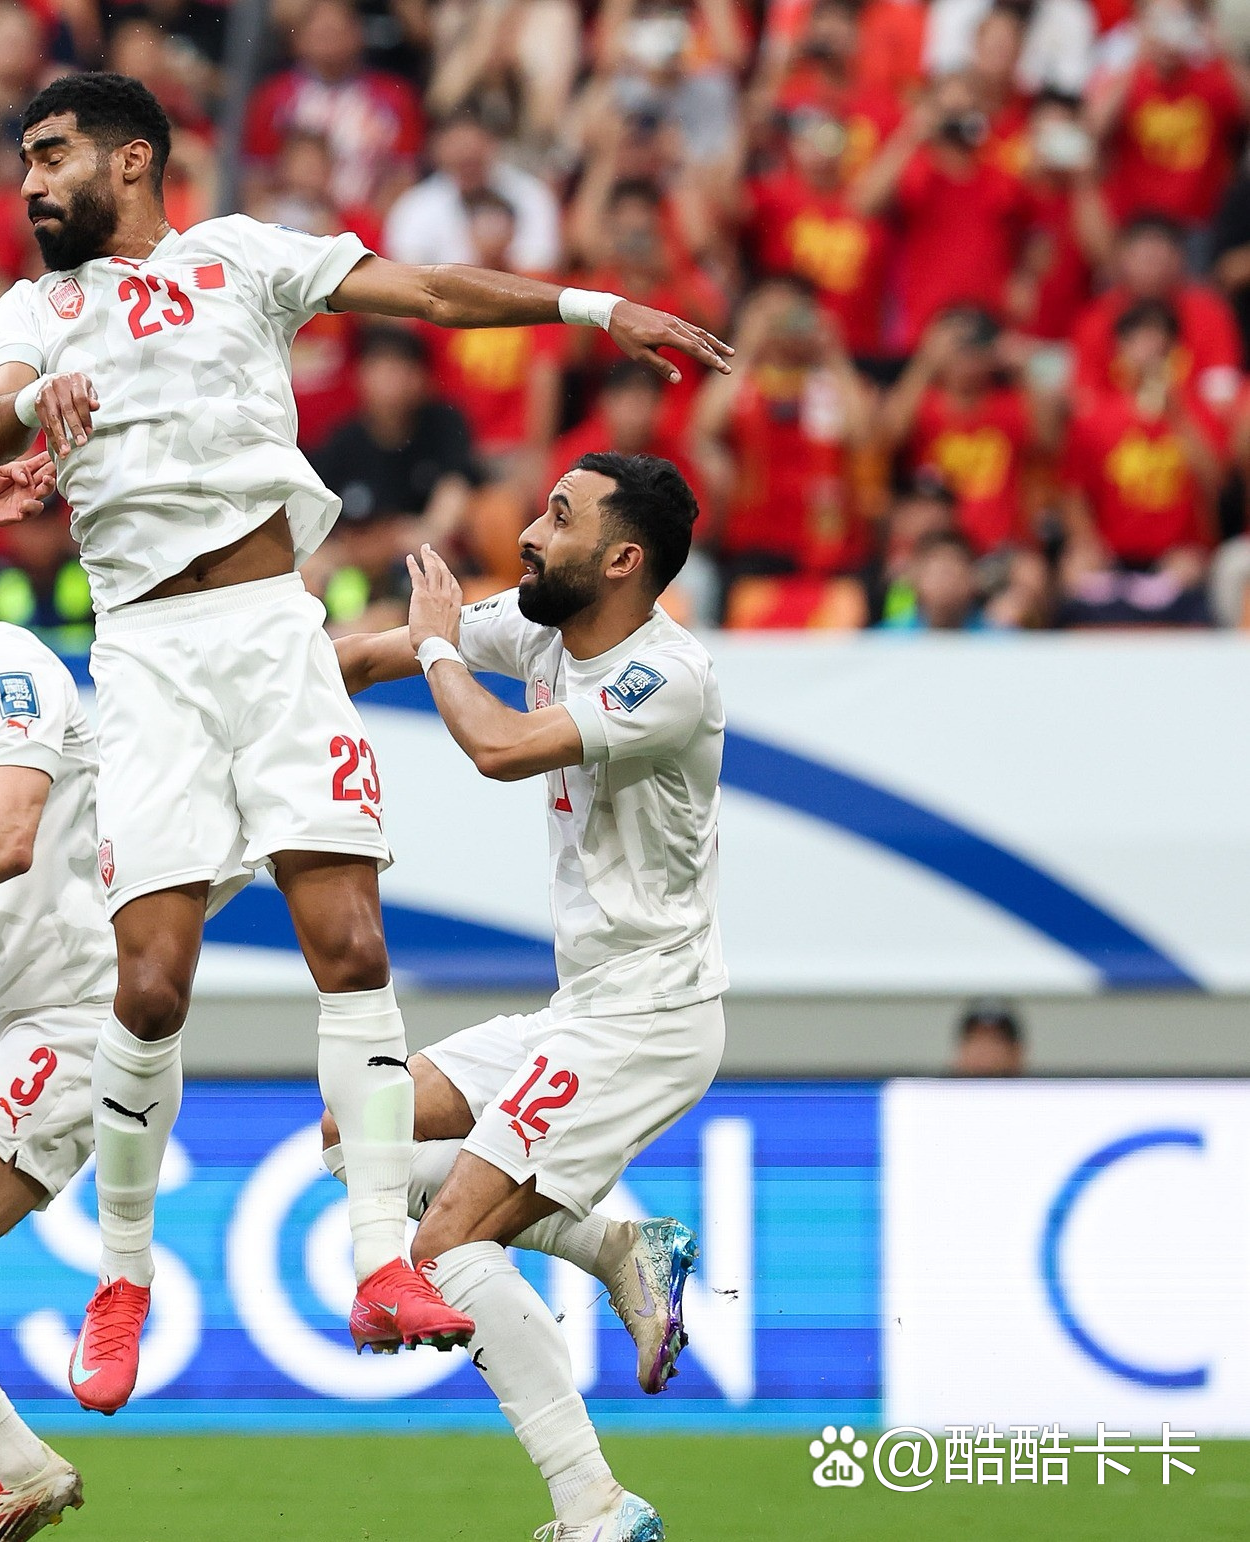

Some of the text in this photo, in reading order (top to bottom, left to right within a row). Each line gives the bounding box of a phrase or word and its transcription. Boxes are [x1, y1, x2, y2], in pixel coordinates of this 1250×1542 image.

[118, 274, 195, 340] 23
[329, 734, 383, 804] 23
[10, 1046, 58, 1107] 3
[498, 1054, 580, 1135] 12
